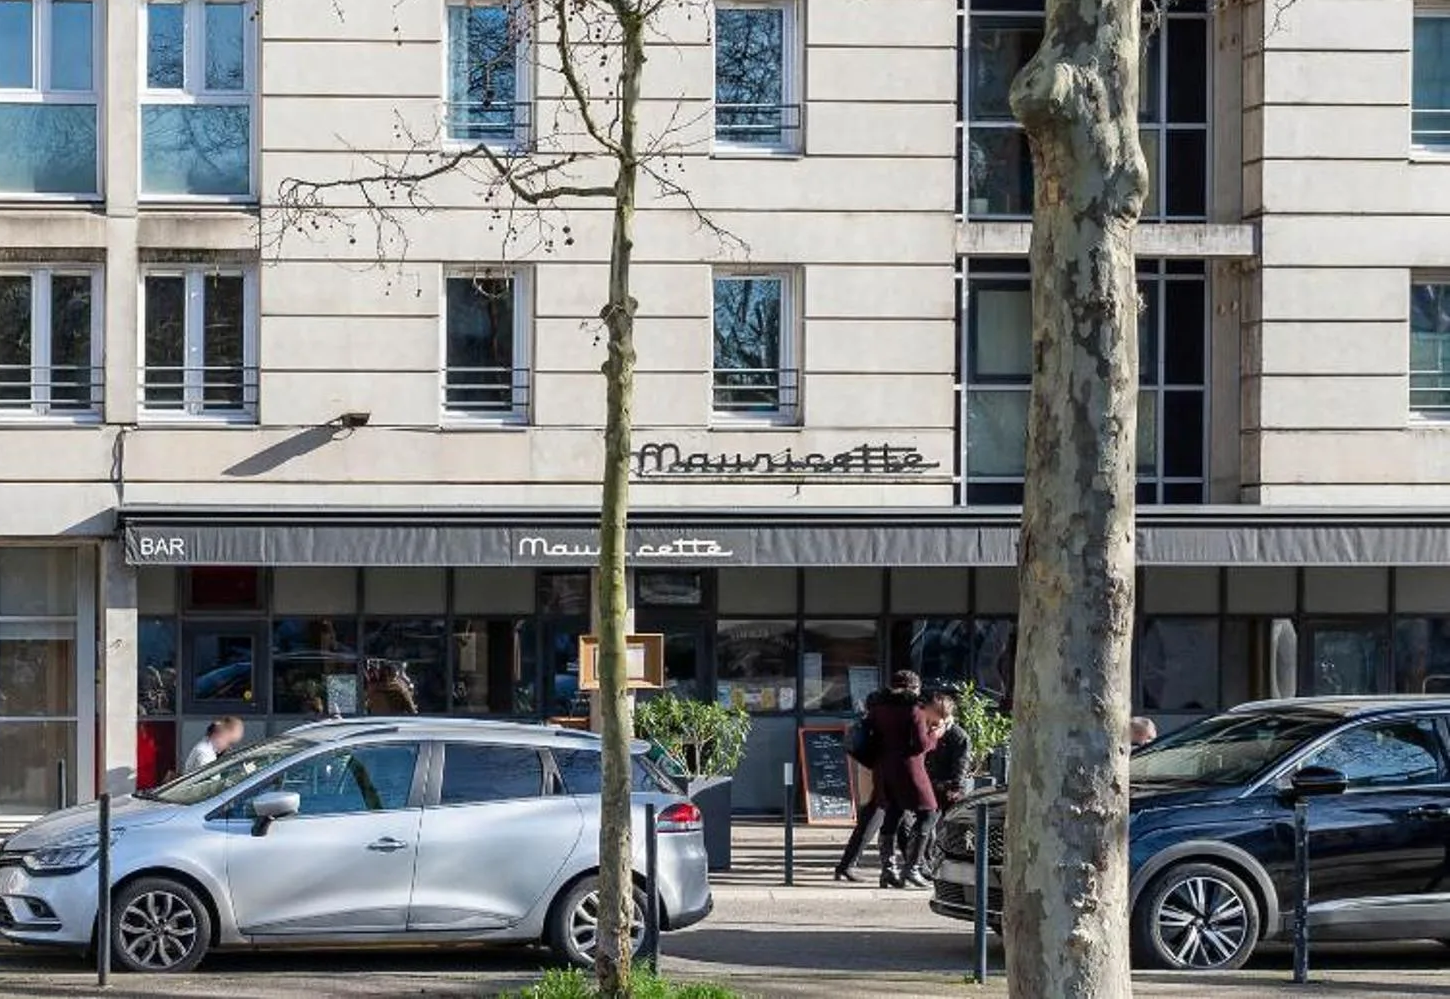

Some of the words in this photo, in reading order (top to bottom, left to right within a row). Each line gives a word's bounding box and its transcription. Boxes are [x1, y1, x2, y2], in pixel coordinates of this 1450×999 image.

[639, 443, 940, 477] Mauricette
[140, 537, 185, 555] BAR
[519, 537, 733, 556] Maucette
